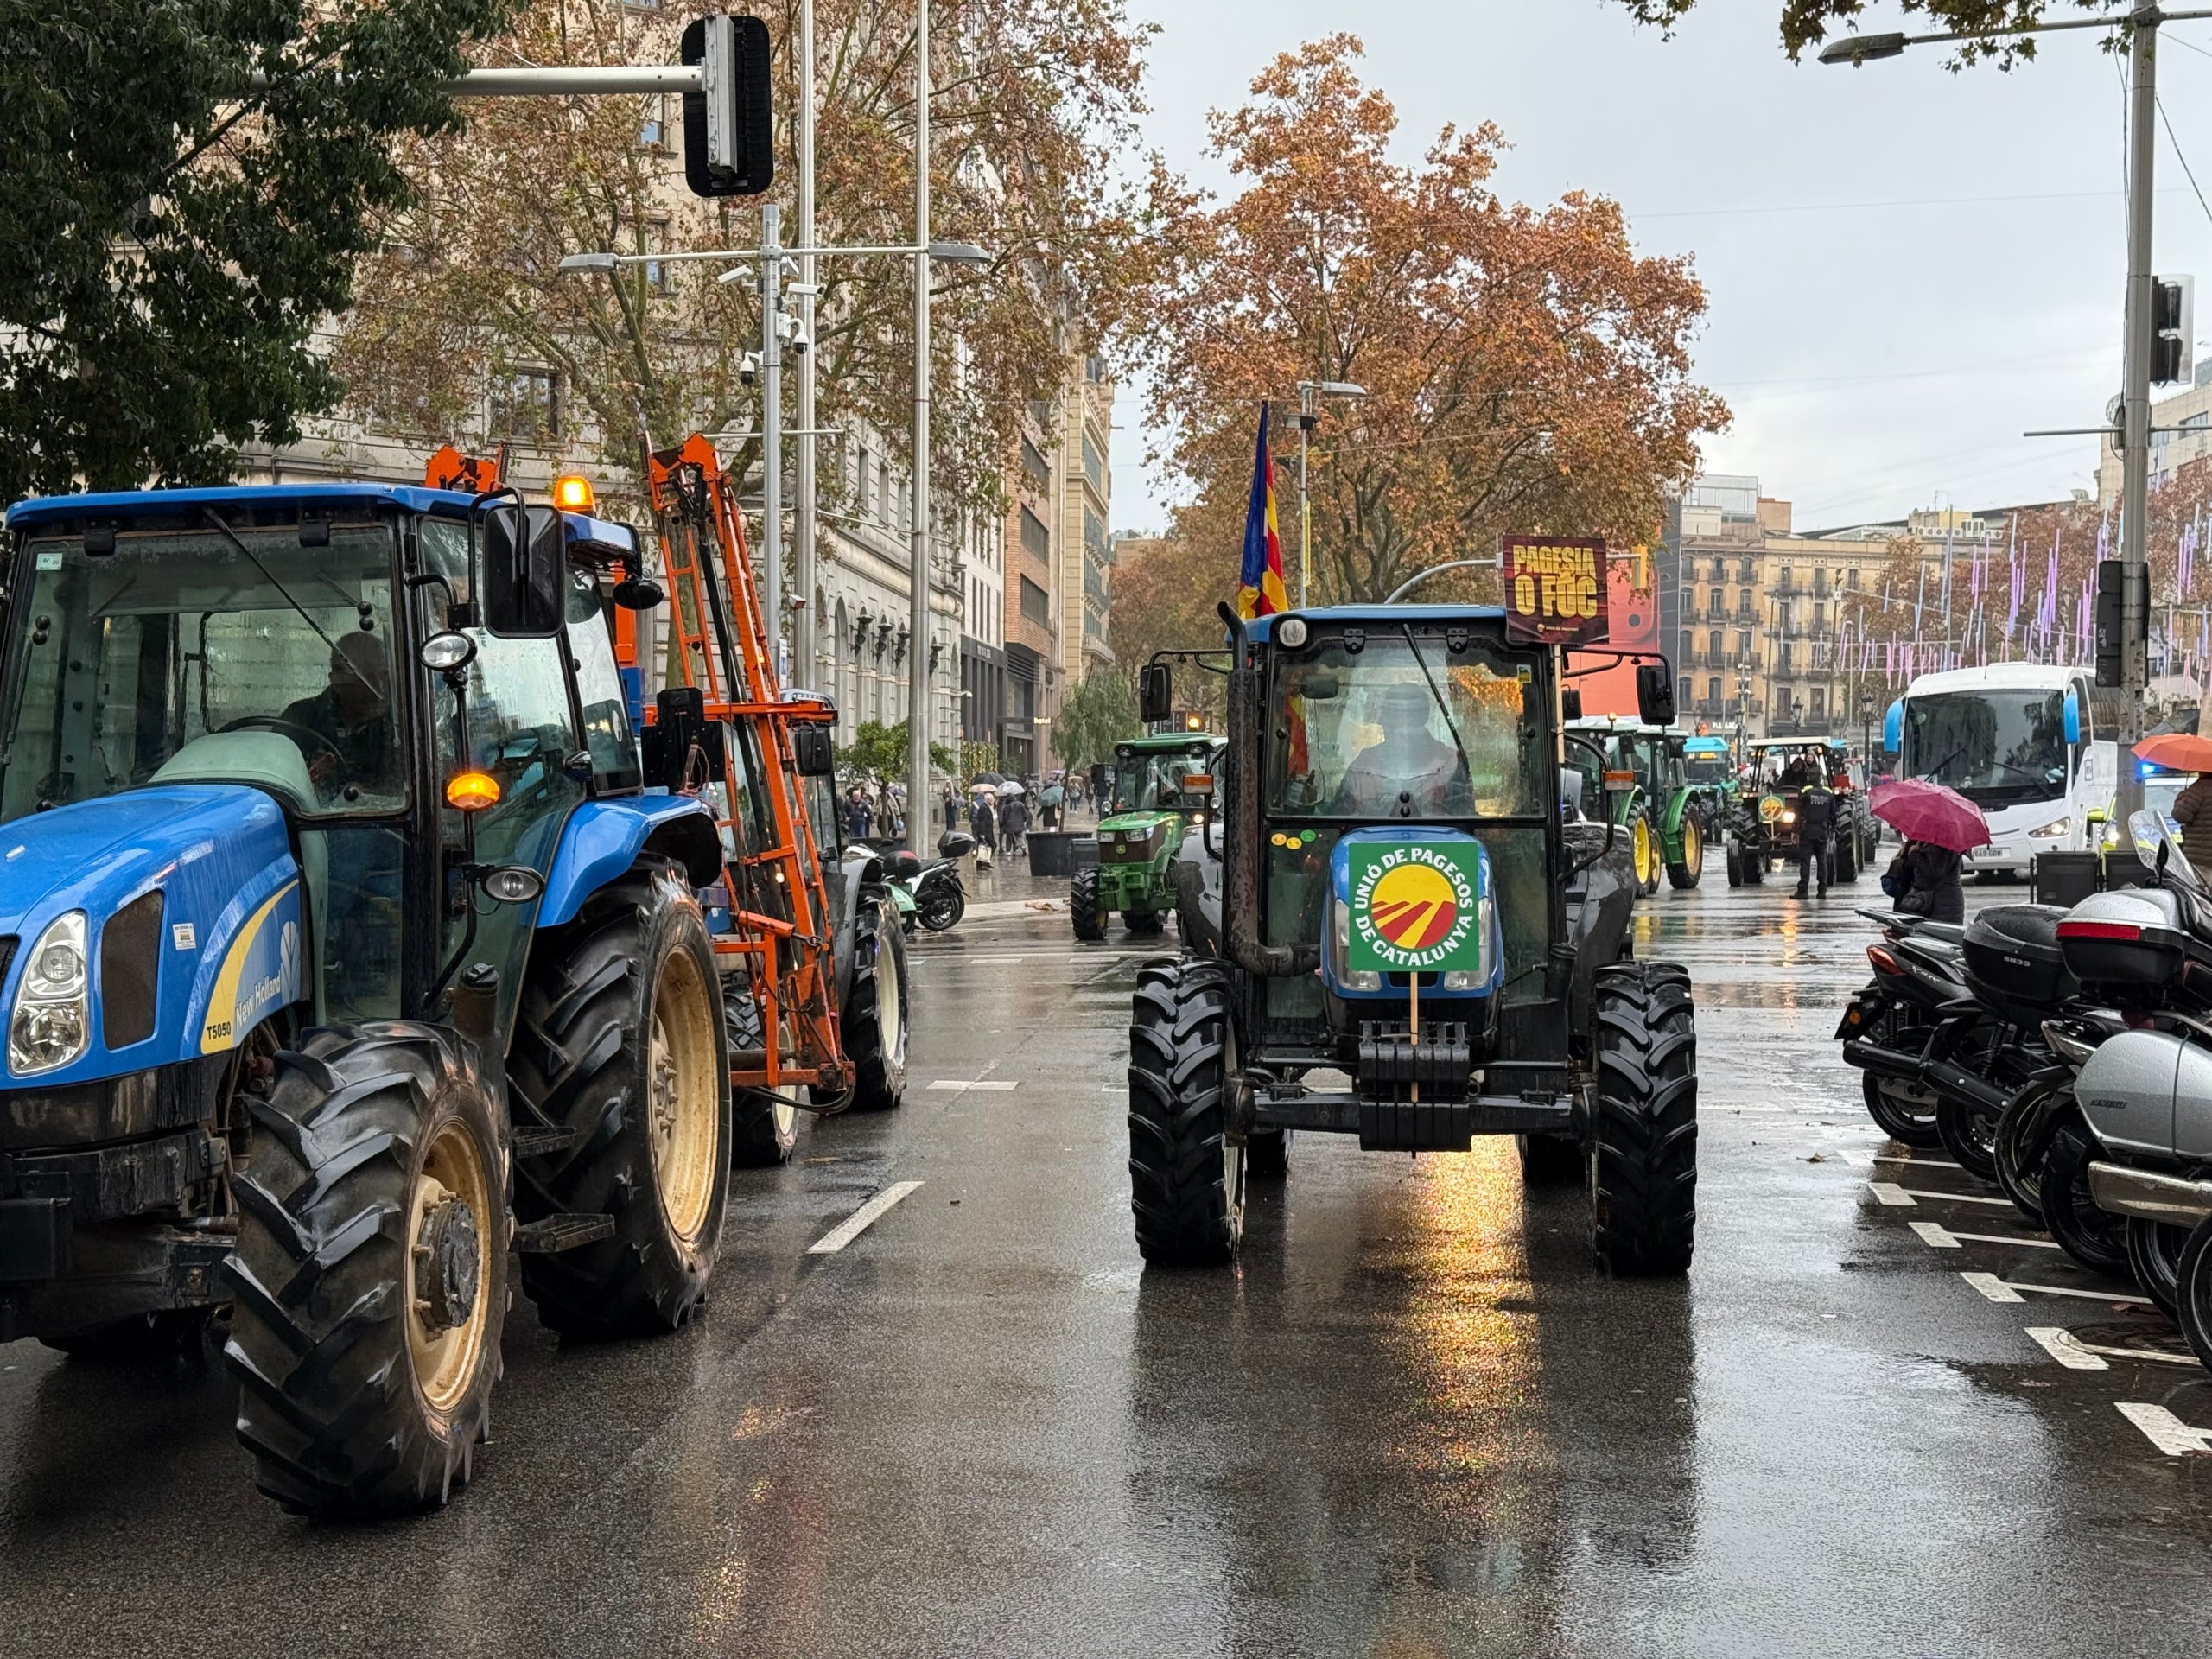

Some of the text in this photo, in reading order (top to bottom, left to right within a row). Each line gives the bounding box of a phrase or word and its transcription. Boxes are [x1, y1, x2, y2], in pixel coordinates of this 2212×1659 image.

[1513, 545, 1596, 579] PAGESIA
[1515, 575, 1598, 619] O FOC
[1354, 847, 1474, 910] UNIÓ DE PAGESOS
[1355, 915, 1473, 966] DE CATALUNYA
[235, 969, 282, 1033] New Holland
[207, 1020, 232, 1040] T5050
